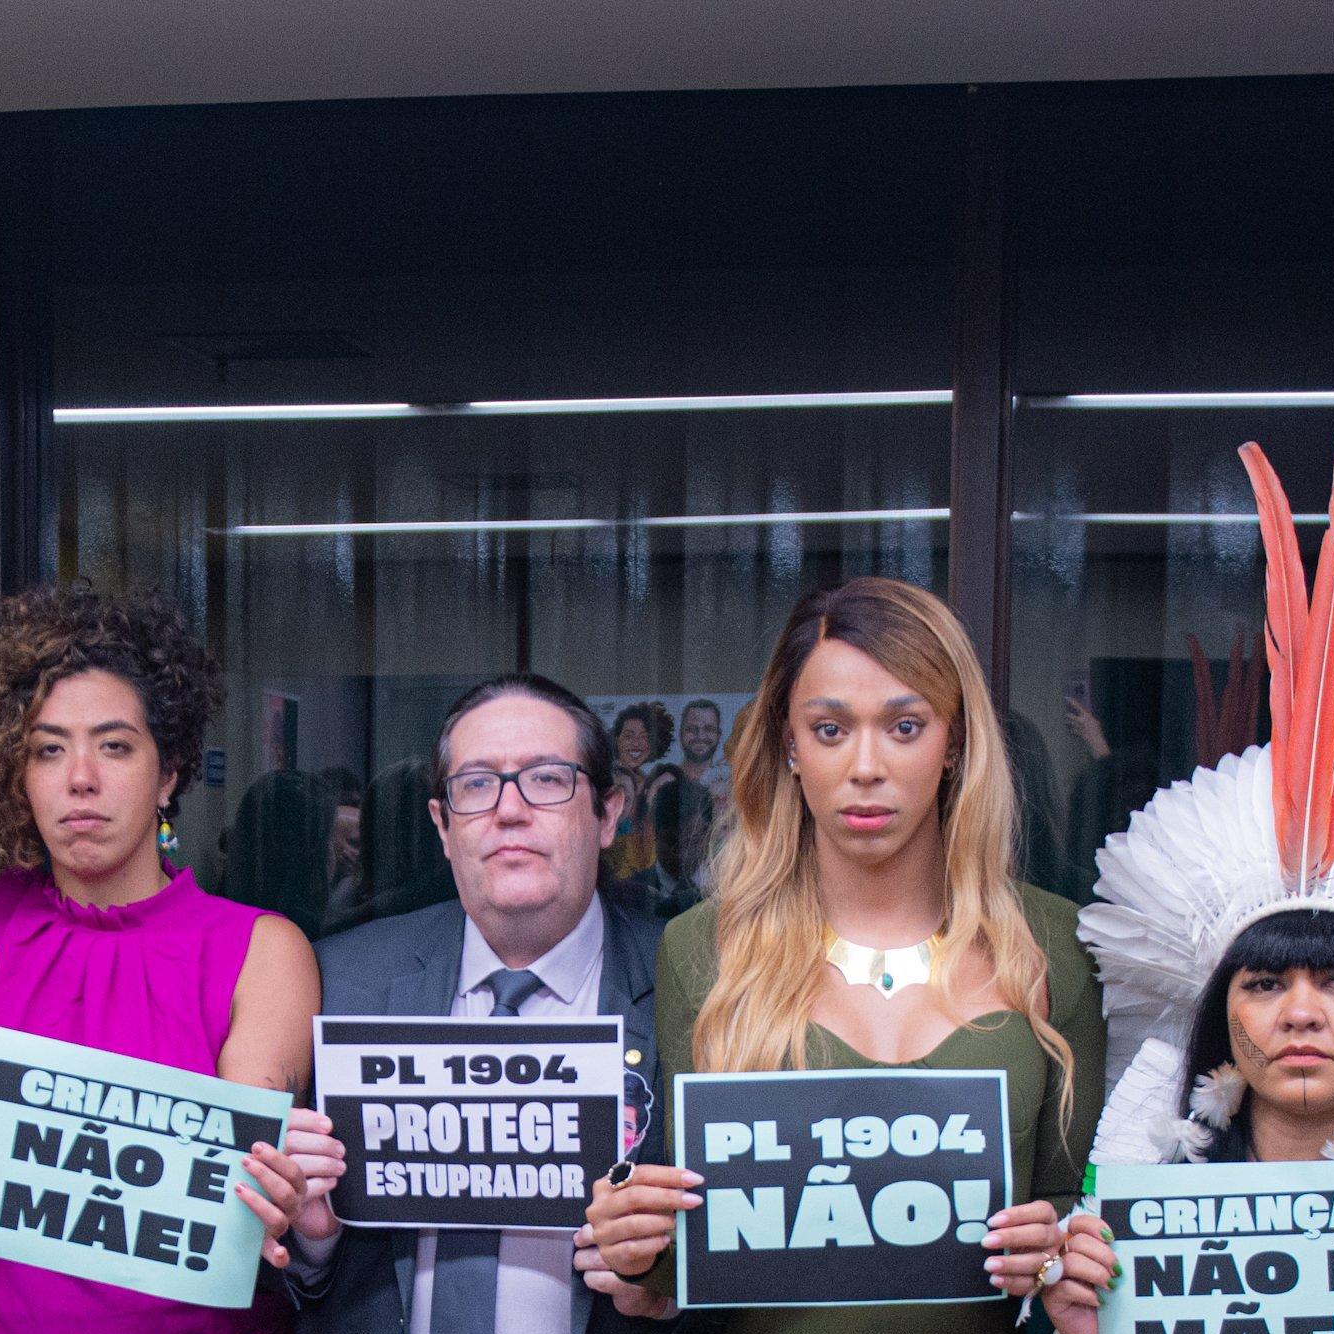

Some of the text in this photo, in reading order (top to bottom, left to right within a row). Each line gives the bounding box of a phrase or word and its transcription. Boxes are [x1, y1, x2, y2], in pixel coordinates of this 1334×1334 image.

[360, 1054, 579, 1085] PL 1904
[20, 1068, 235, 1145] CRIANÇA
[362, 1102, 581, 1154] PROTEGE
[12, 1120, 229, 1205] NÃO É
[704, 1113, 986, 1163] PL 1904
[365, 1161, 585, 1199] ESTUPRADOR
[707, 1165, 991, 1252] NÃO!
[1133, 1241, 1299, 1298] NÃO
